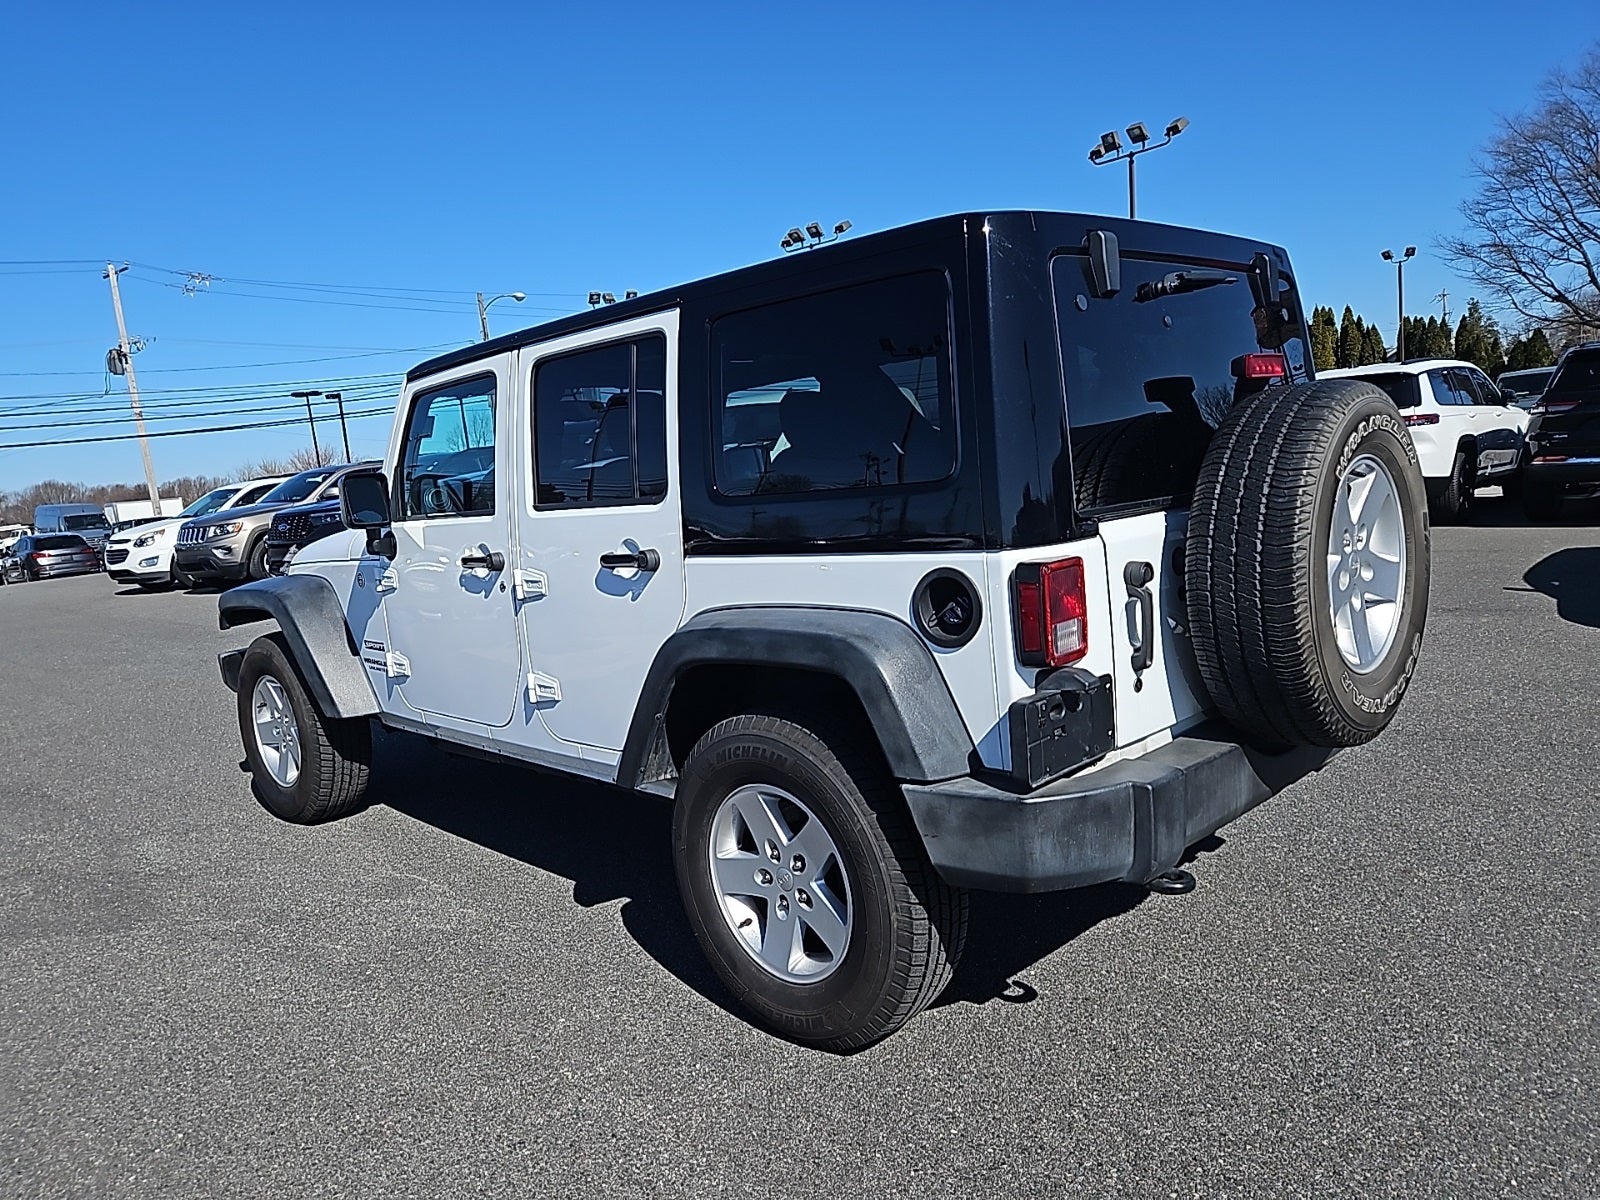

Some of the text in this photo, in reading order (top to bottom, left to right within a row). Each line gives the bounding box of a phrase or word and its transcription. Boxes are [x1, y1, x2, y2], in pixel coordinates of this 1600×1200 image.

[1335, 415, 1417, 479] WRANGLER
[1341, 632, 1420, 713] GOODYEAR
[715, 744, 793, 771] MICHELIN
